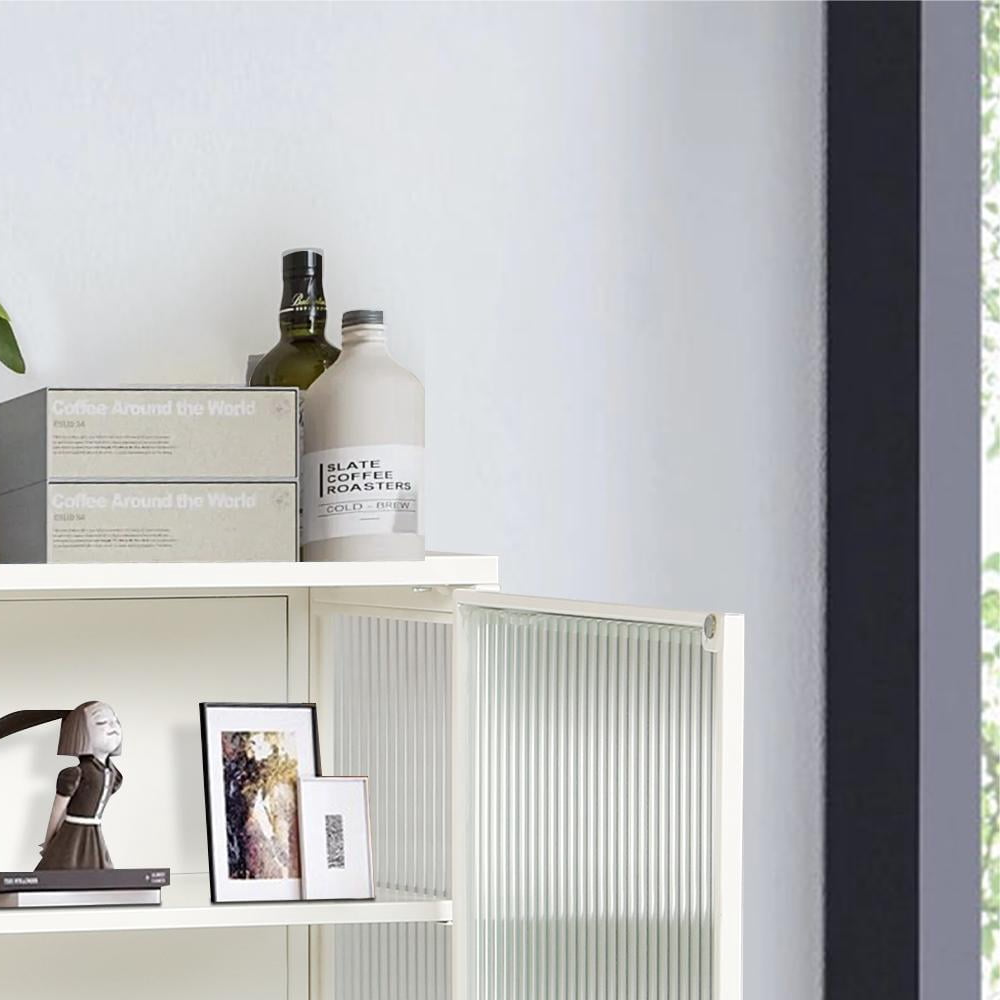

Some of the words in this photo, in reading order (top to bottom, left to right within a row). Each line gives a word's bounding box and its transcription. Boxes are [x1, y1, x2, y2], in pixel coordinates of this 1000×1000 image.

[52, 400, 107, 416] Coffee
[113, 400, 172, 416] Around
[176, 400, 204, 416] the
[208, 400, 255, 416] World
[327, 460, 381, 473] SLATE
[327, 471, 393, 484] COFFEE
[327, 482, 412, 495] ROASTERS
[52, 492, 107, 509] Coffee
[112, 492, 172, 509] Around
[176, 492, 204, 509] the
[208, 491, 256, 509] World
[326, 503, 363, 514] COLD
[376, 501, 410, 509] BREW
